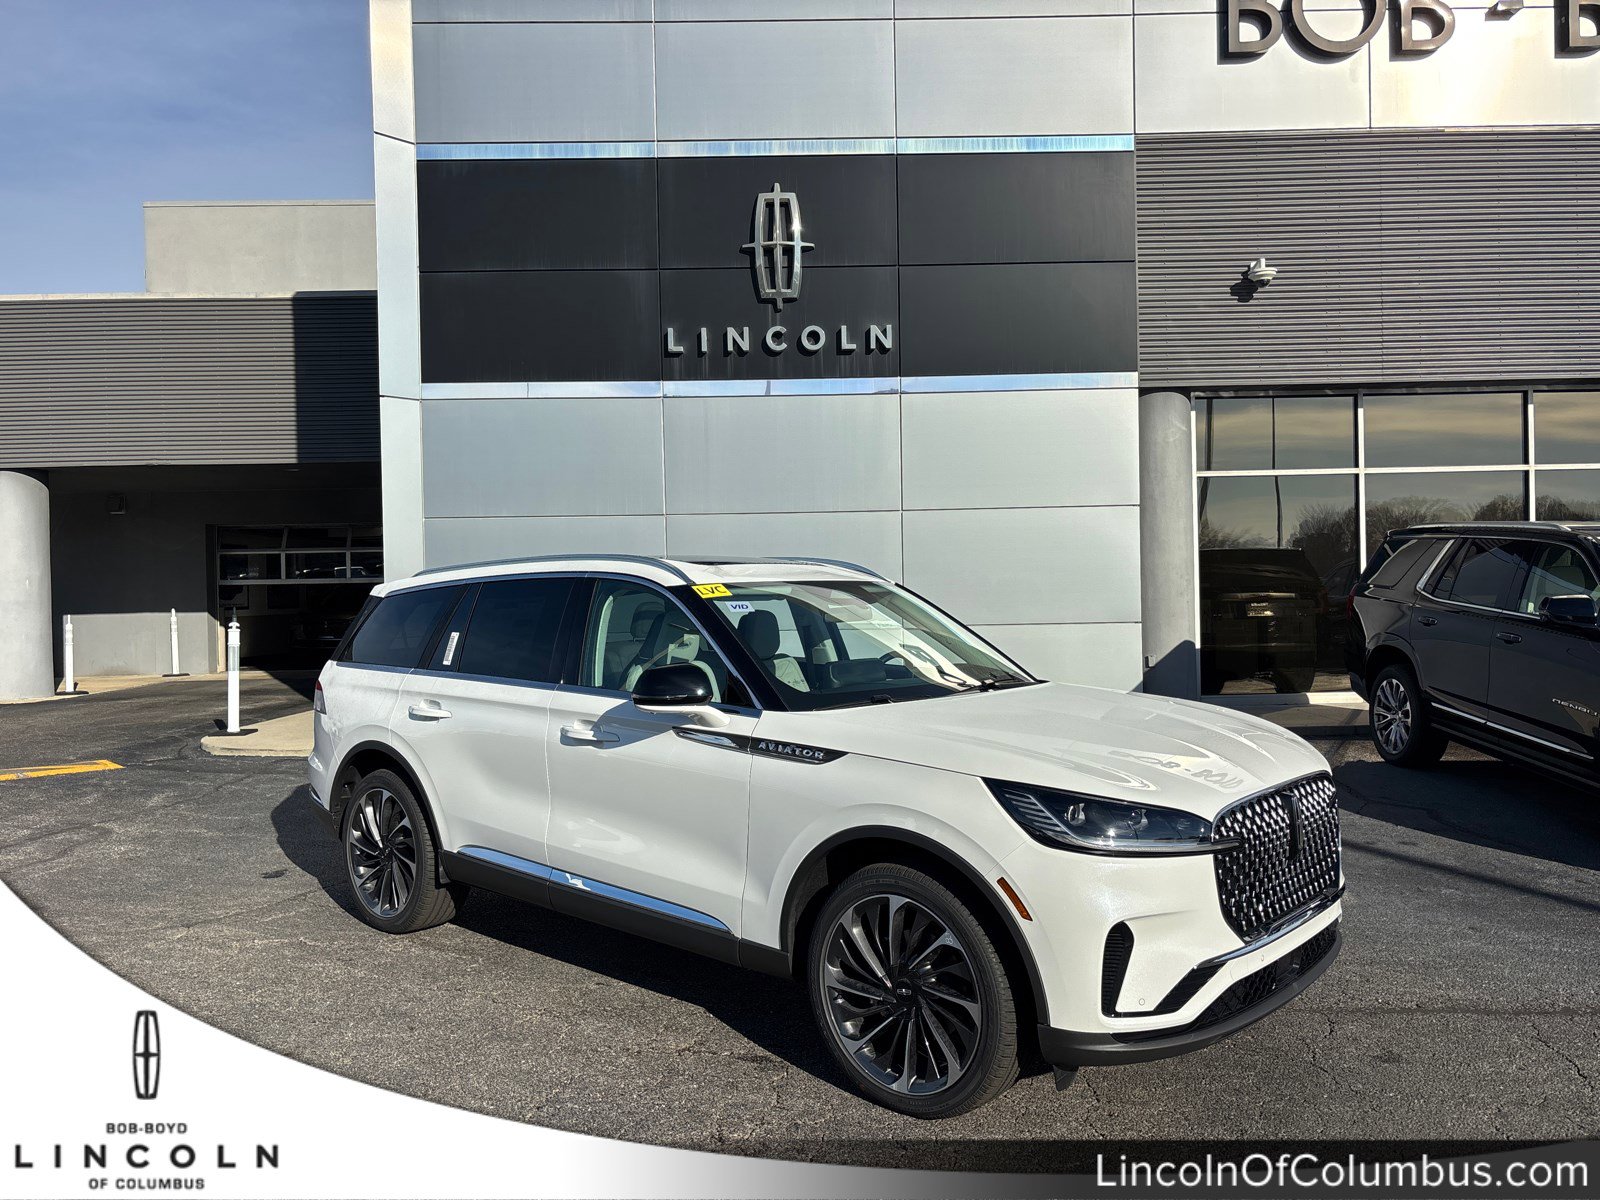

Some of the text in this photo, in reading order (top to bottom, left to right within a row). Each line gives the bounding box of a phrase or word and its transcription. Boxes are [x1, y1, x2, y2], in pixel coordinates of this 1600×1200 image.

[665, 324, 893, 354] LINCOLN
[696, 585, 727, 596] LVC
[758, 740, 824, 760] AVIATOR
